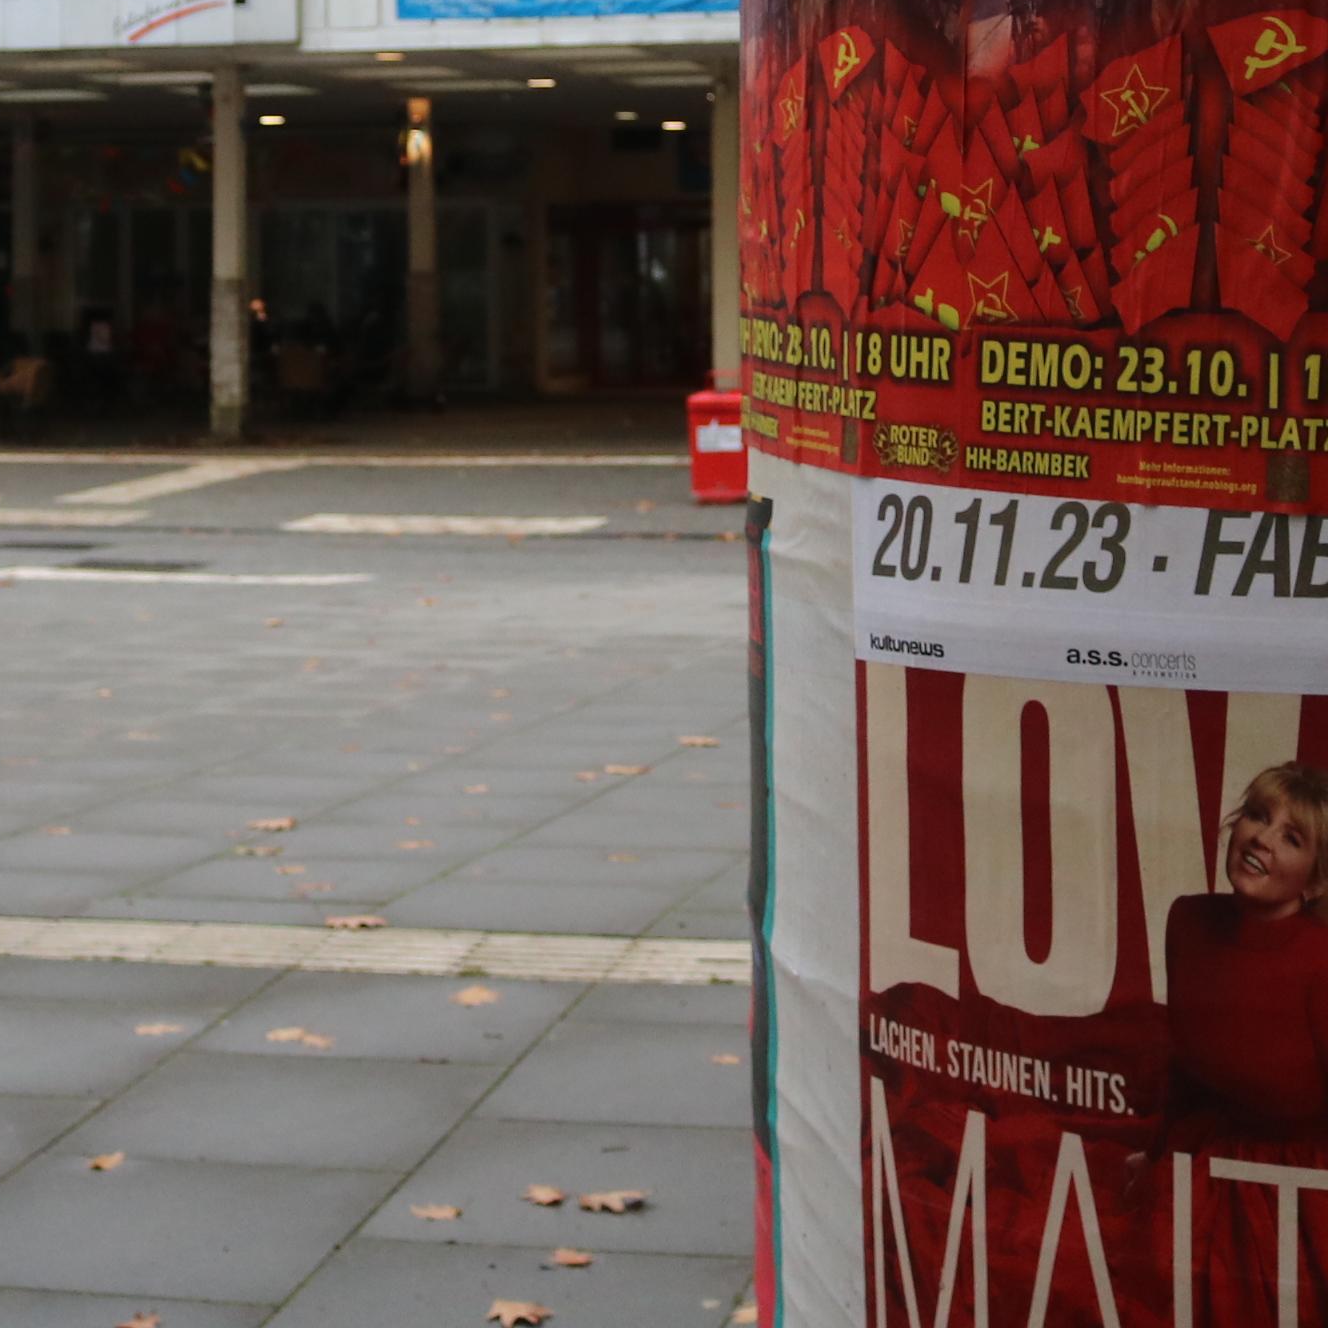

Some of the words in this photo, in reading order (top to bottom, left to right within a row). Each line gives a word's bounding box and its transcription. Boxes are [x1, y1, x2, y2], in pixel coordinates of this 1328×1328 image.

[855, 331, 883, 376] 18
[889, 334, 952, 381] UHR
[980, 339, 1105, 391] DEMO:
[1116, 345, 1248, 398] 23.10.
[889, 424, 939, 449] ROTER
[896, 447, 931, 468] BUND
[964, 445, 1091, 480] HH-BARMBEK
[872, 493, 1131, 595] 20.11.23
[1065, 644, 1128, 671] a.s.s.
[1131, 649, 1198, 673] concerts
[869, 1012, 942, 1073] LACHEN.
[946, 1039, 1059, 1103] STAUNEN.
[1066, 1065, 1135, 1116] HITS.
